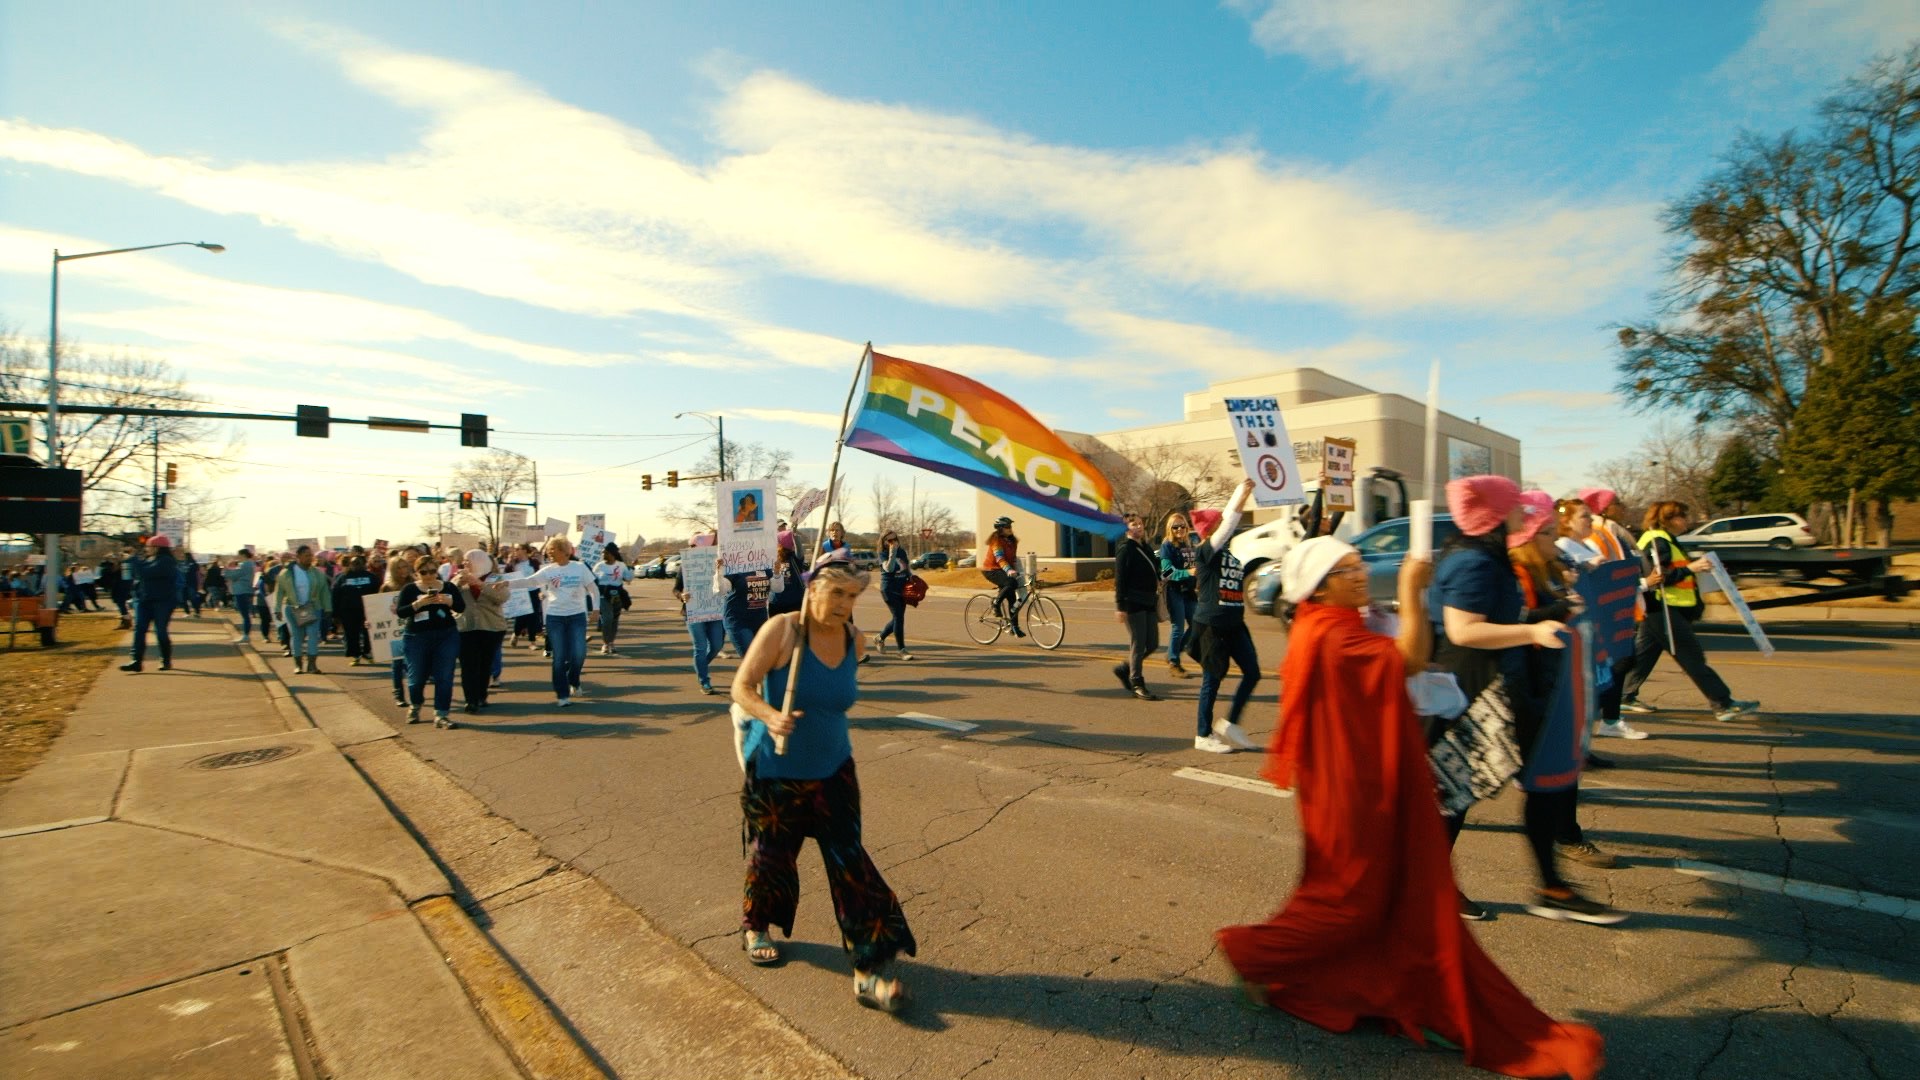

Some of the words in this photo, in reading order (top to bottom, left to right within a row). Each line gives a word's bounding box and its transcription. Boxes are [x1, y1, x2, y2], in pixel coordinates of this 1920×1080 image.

[1225, 399, 1280, 412] IMPEACH
[1236, 414, 1275, 428] THIS
[906, 385, 1100, 511] PEACE
[722, 550, 745, 566] SAVE
[747, 548, 769, 562] OUR
[1220, 567, 1244, 581] VOTE
